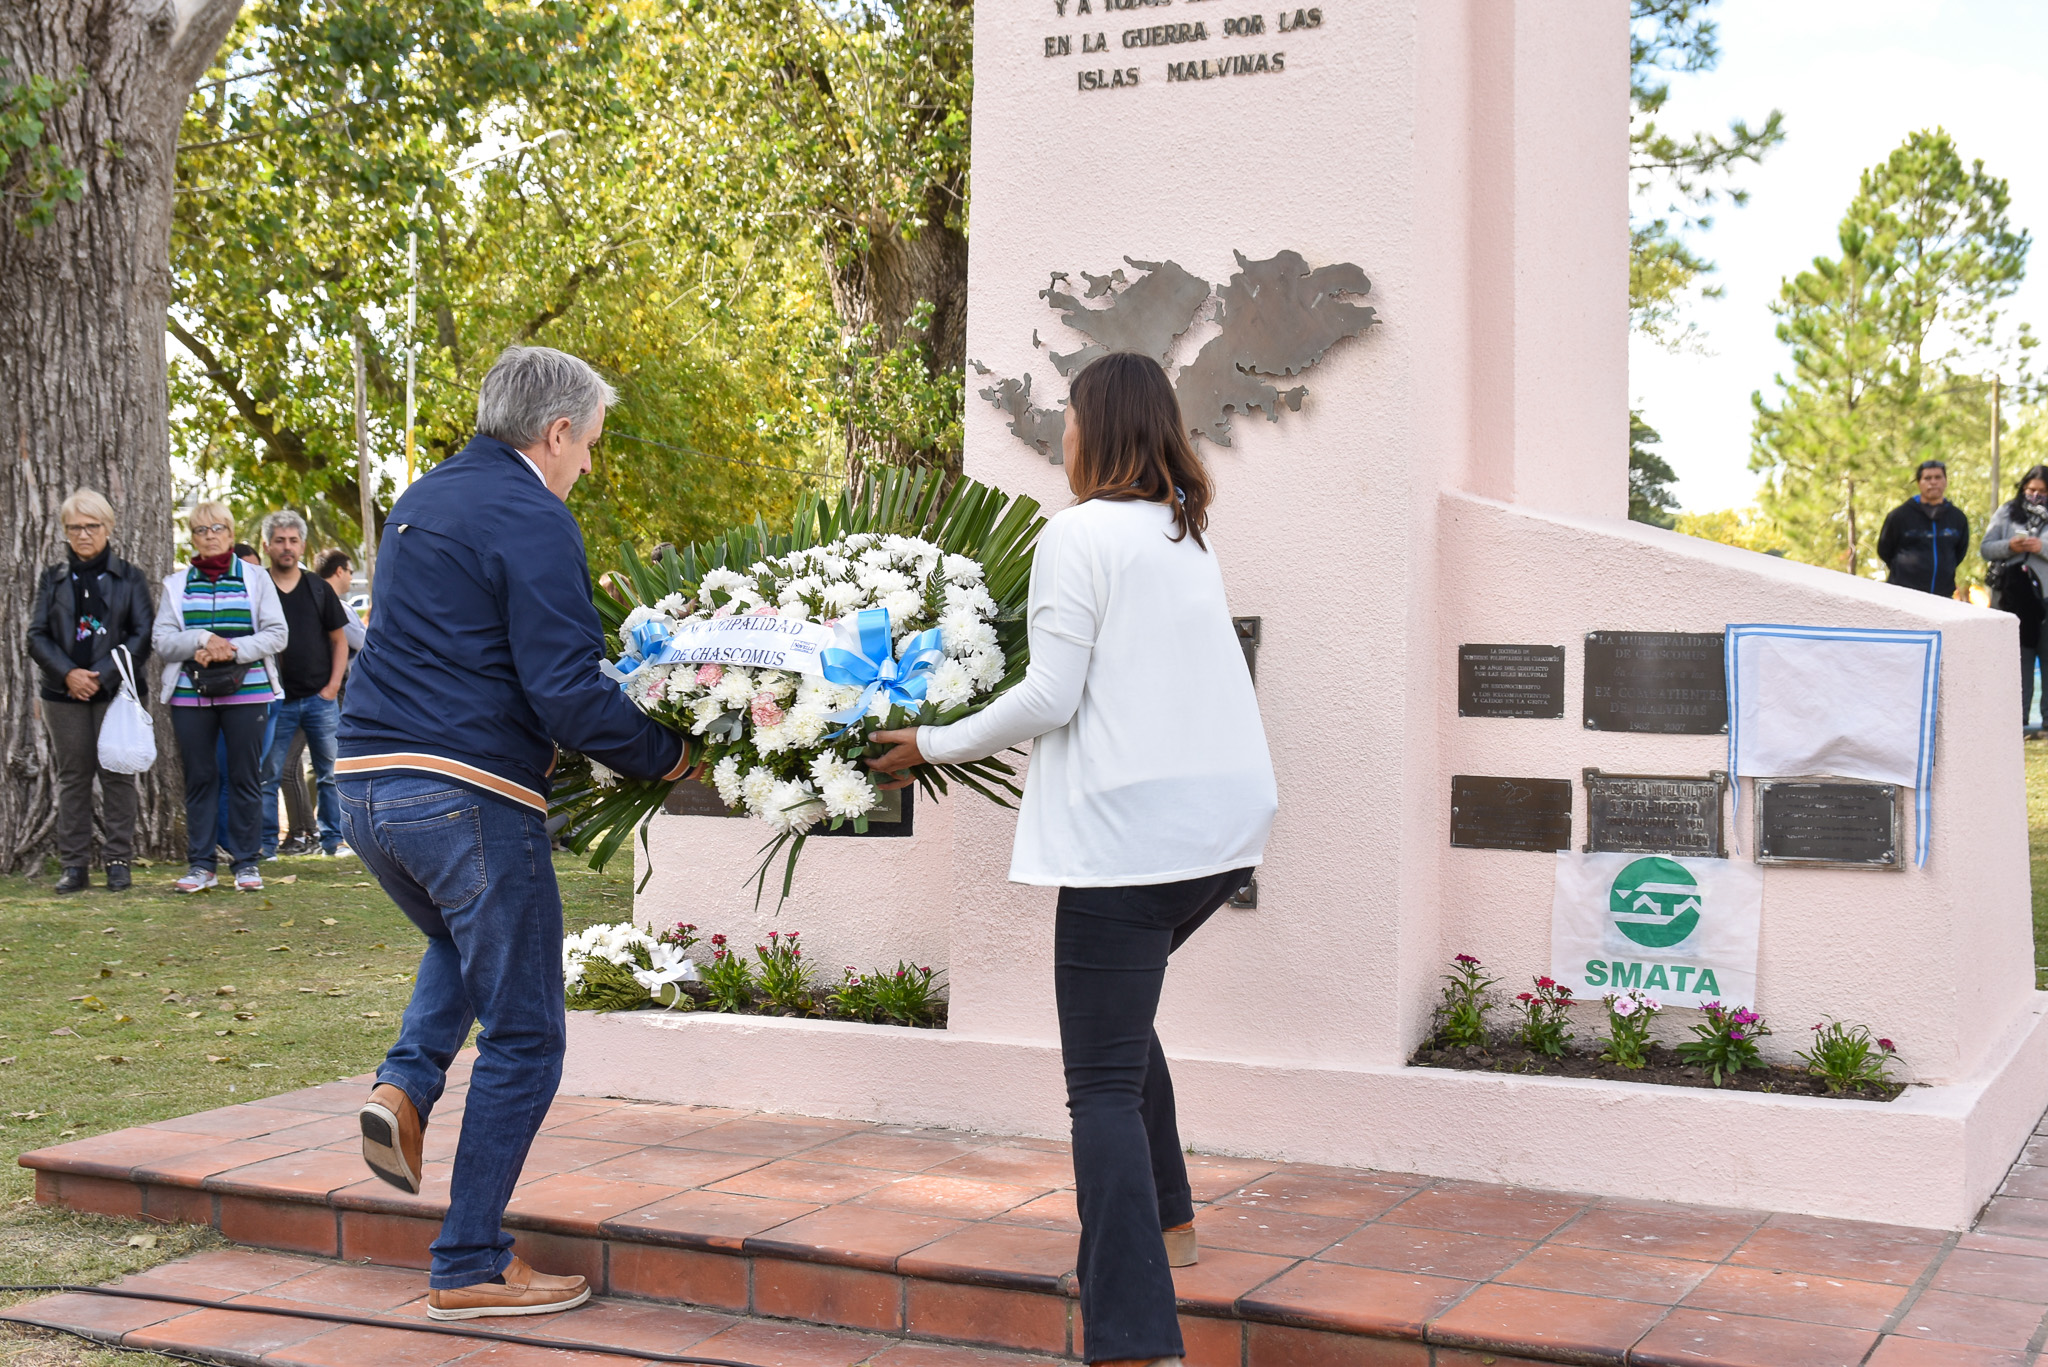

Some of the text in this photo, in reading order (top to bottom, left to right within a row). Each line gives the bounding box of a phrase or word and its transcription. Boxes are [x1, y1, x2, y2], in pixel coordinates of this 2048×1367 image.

[1045, 7, 1324, 57] EN LA GUERRA POR LAS
[1078, 53, 1286, 90] ISLAS MALVINAS
[670, 647, 786, 666] DE CHASCOMUS
[1584, 959, 1721, 997] SMATA
